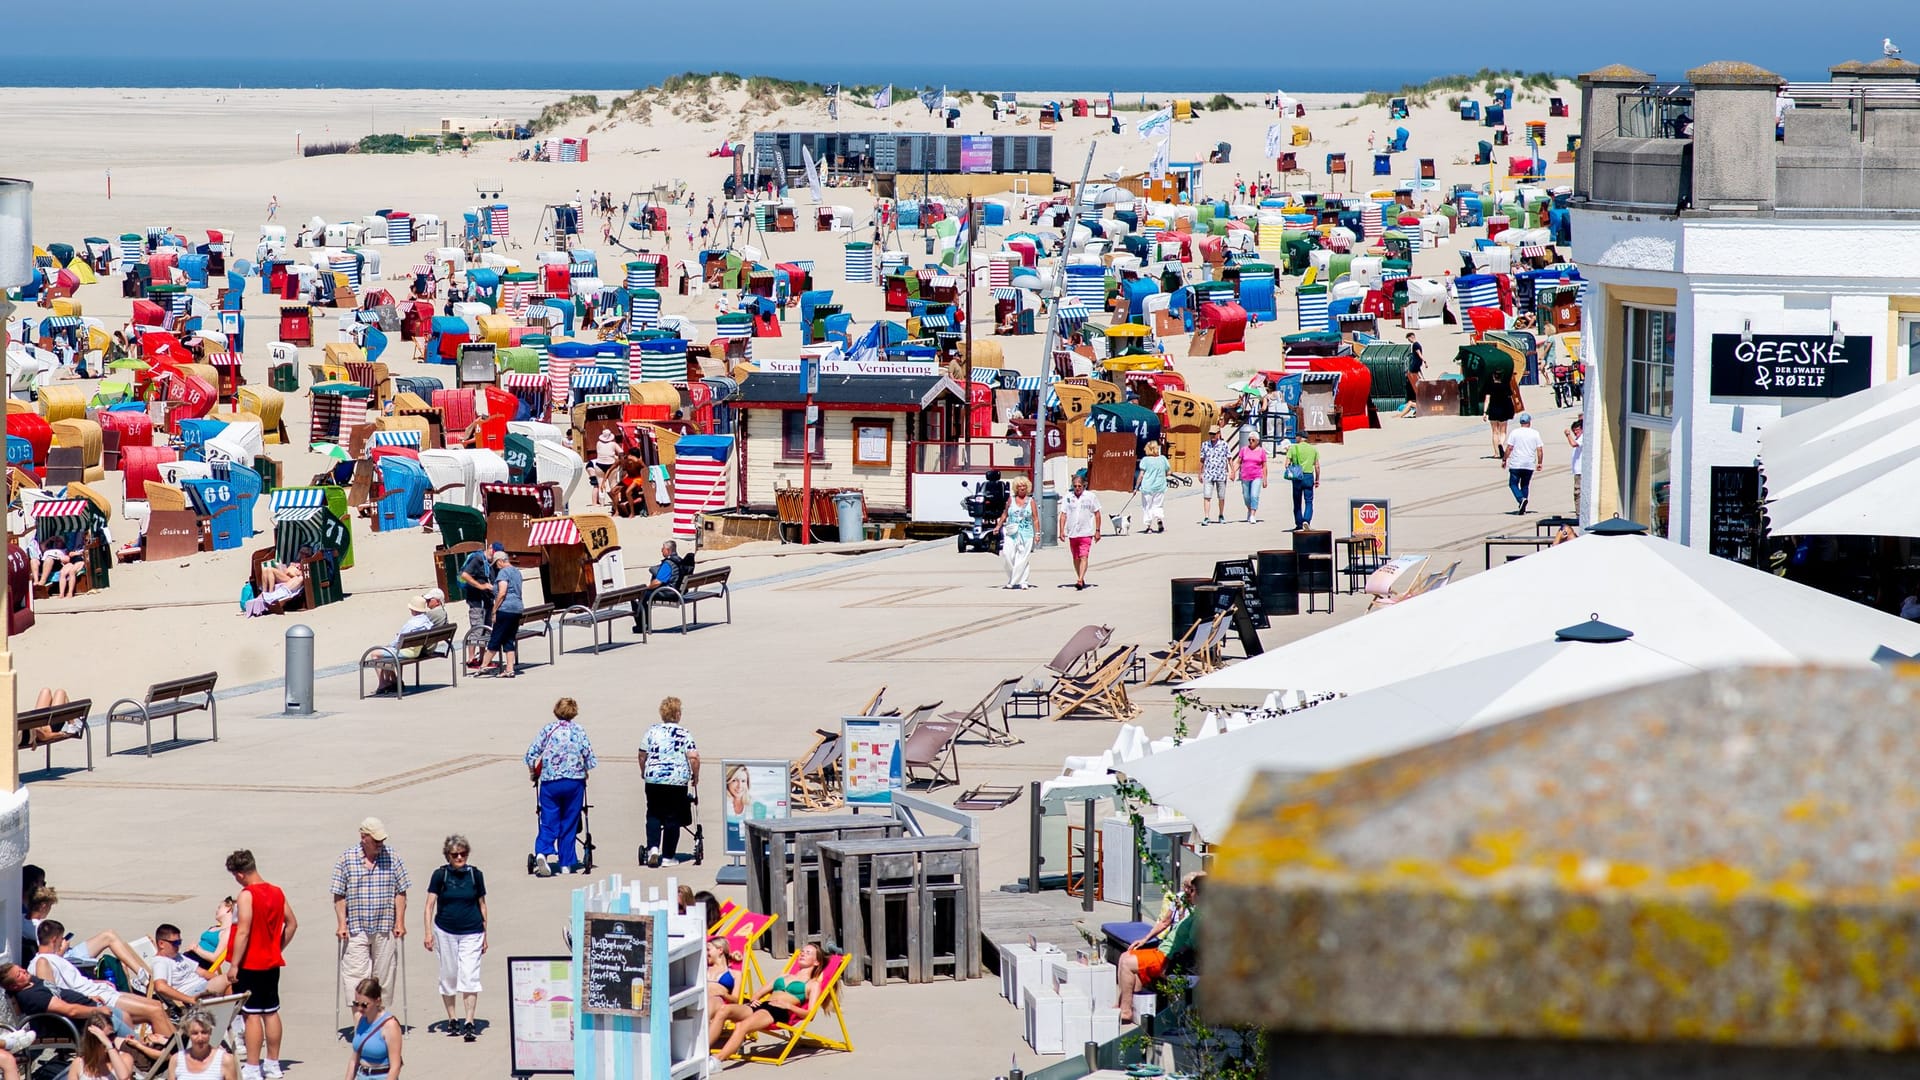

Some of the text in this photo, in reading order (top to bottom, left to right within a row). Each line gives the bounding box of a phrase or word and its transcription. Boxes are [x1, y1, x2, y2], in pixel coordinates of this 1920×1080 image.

[1542, 292, 1553, 304] 88
[273, 349, 286, 360] 40
[1735, 341, 1849, 366] GEESKE
[770, 361, 932, 376] Stranorb Vermietung
[1004, 375, 1016, 389] 62
[1755, 365, 1772, 390] &
[1775, 375, 1825, 387] RØELF
[171, 383, 185, 399] 83
[187, 389, 201, 405] 18
[972, 390, 984, 403] 12
[1097, 391, 1116, 404] 23
[1072, 397, 1082, 413] 5
[1171, 399, 1195, 417] 72
[1097, 413, 1118, 433] 74
[1311, 411, 1324, 426] 73
[1132, 420, 1148, 439] 74
[507, 450, 528, 468] 28
[167, 469, 177, 484] 6
[204, 485, 231, 504] 66
[1360, 509, 1378, 519] STOP
[326, 518, 342, 546] 71
[589, 981, 607, 991] Bier
